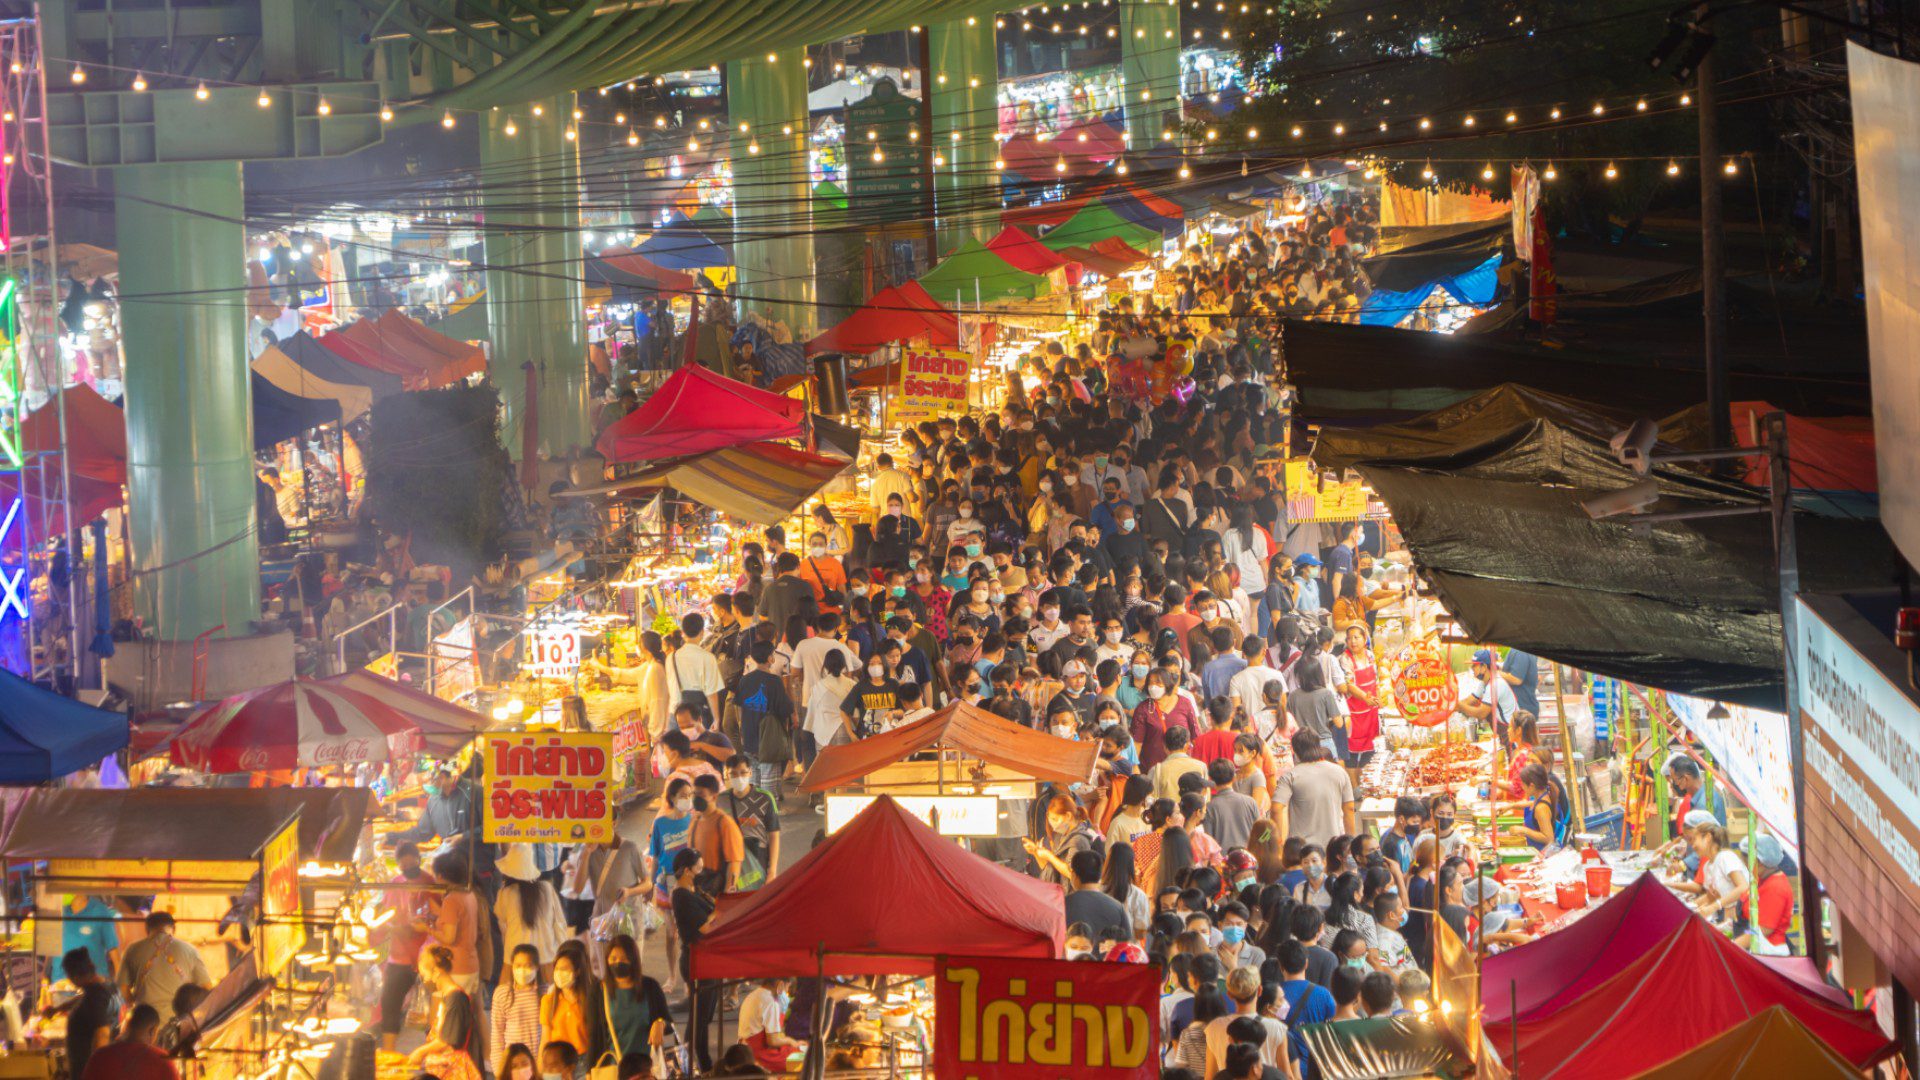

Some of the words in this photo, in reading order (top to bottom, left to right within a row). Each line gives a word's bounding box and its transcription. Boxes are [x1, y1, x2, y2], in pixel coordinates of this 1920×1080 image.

[906, 351, 968, 376] ไก่ย่าง
[904, 374, 967, 400] จีระพันธ์
[1410, 687, 1440, 704] 100
[490, 737, 605, 776] ไก่ย่าง
[491, 780, 607, 819] จีระพันธ์
[946, 967, 1150, 1068] ไก่ย่าง
